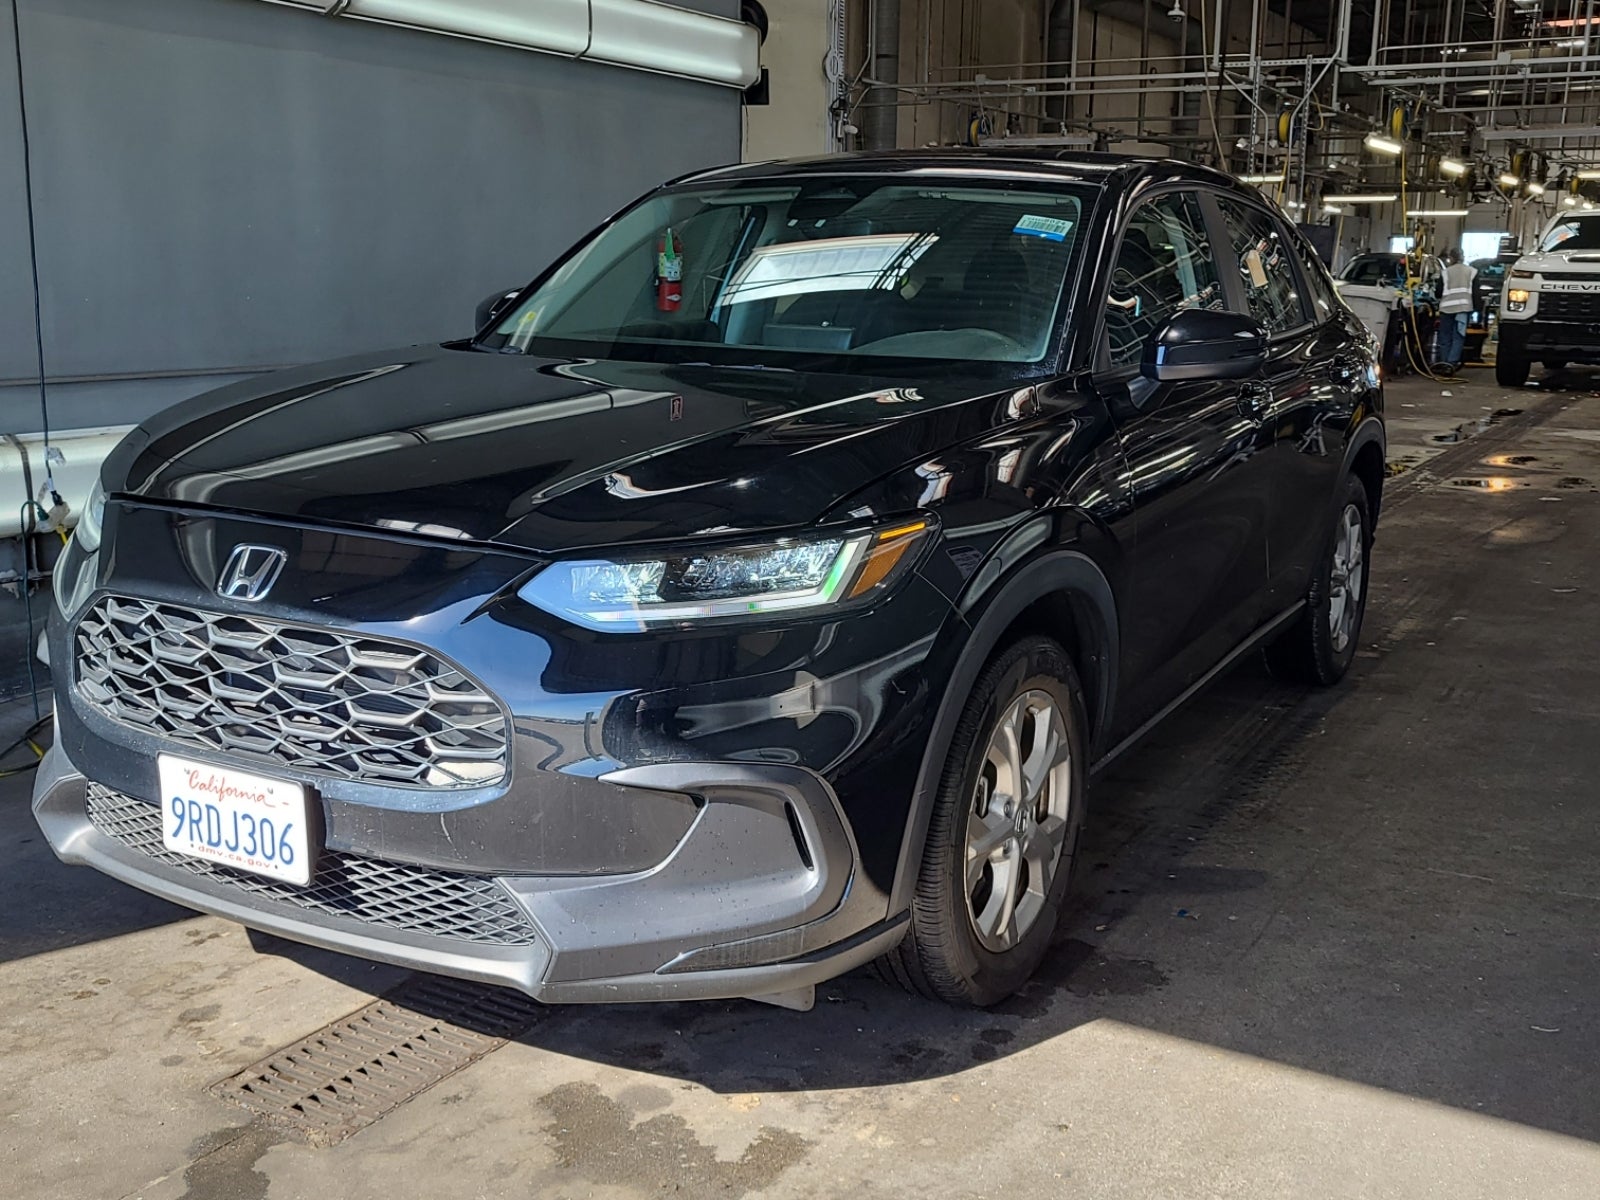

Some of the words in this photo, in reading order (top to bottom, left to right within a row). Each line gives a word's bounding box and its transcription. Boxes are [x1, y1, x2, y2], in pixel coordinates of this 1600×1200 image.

[188, 769, 276, 808] California
[171, 796, 294, 866] 9RDJ306
[198, 843, 271, 867] dmv.ca.gov
